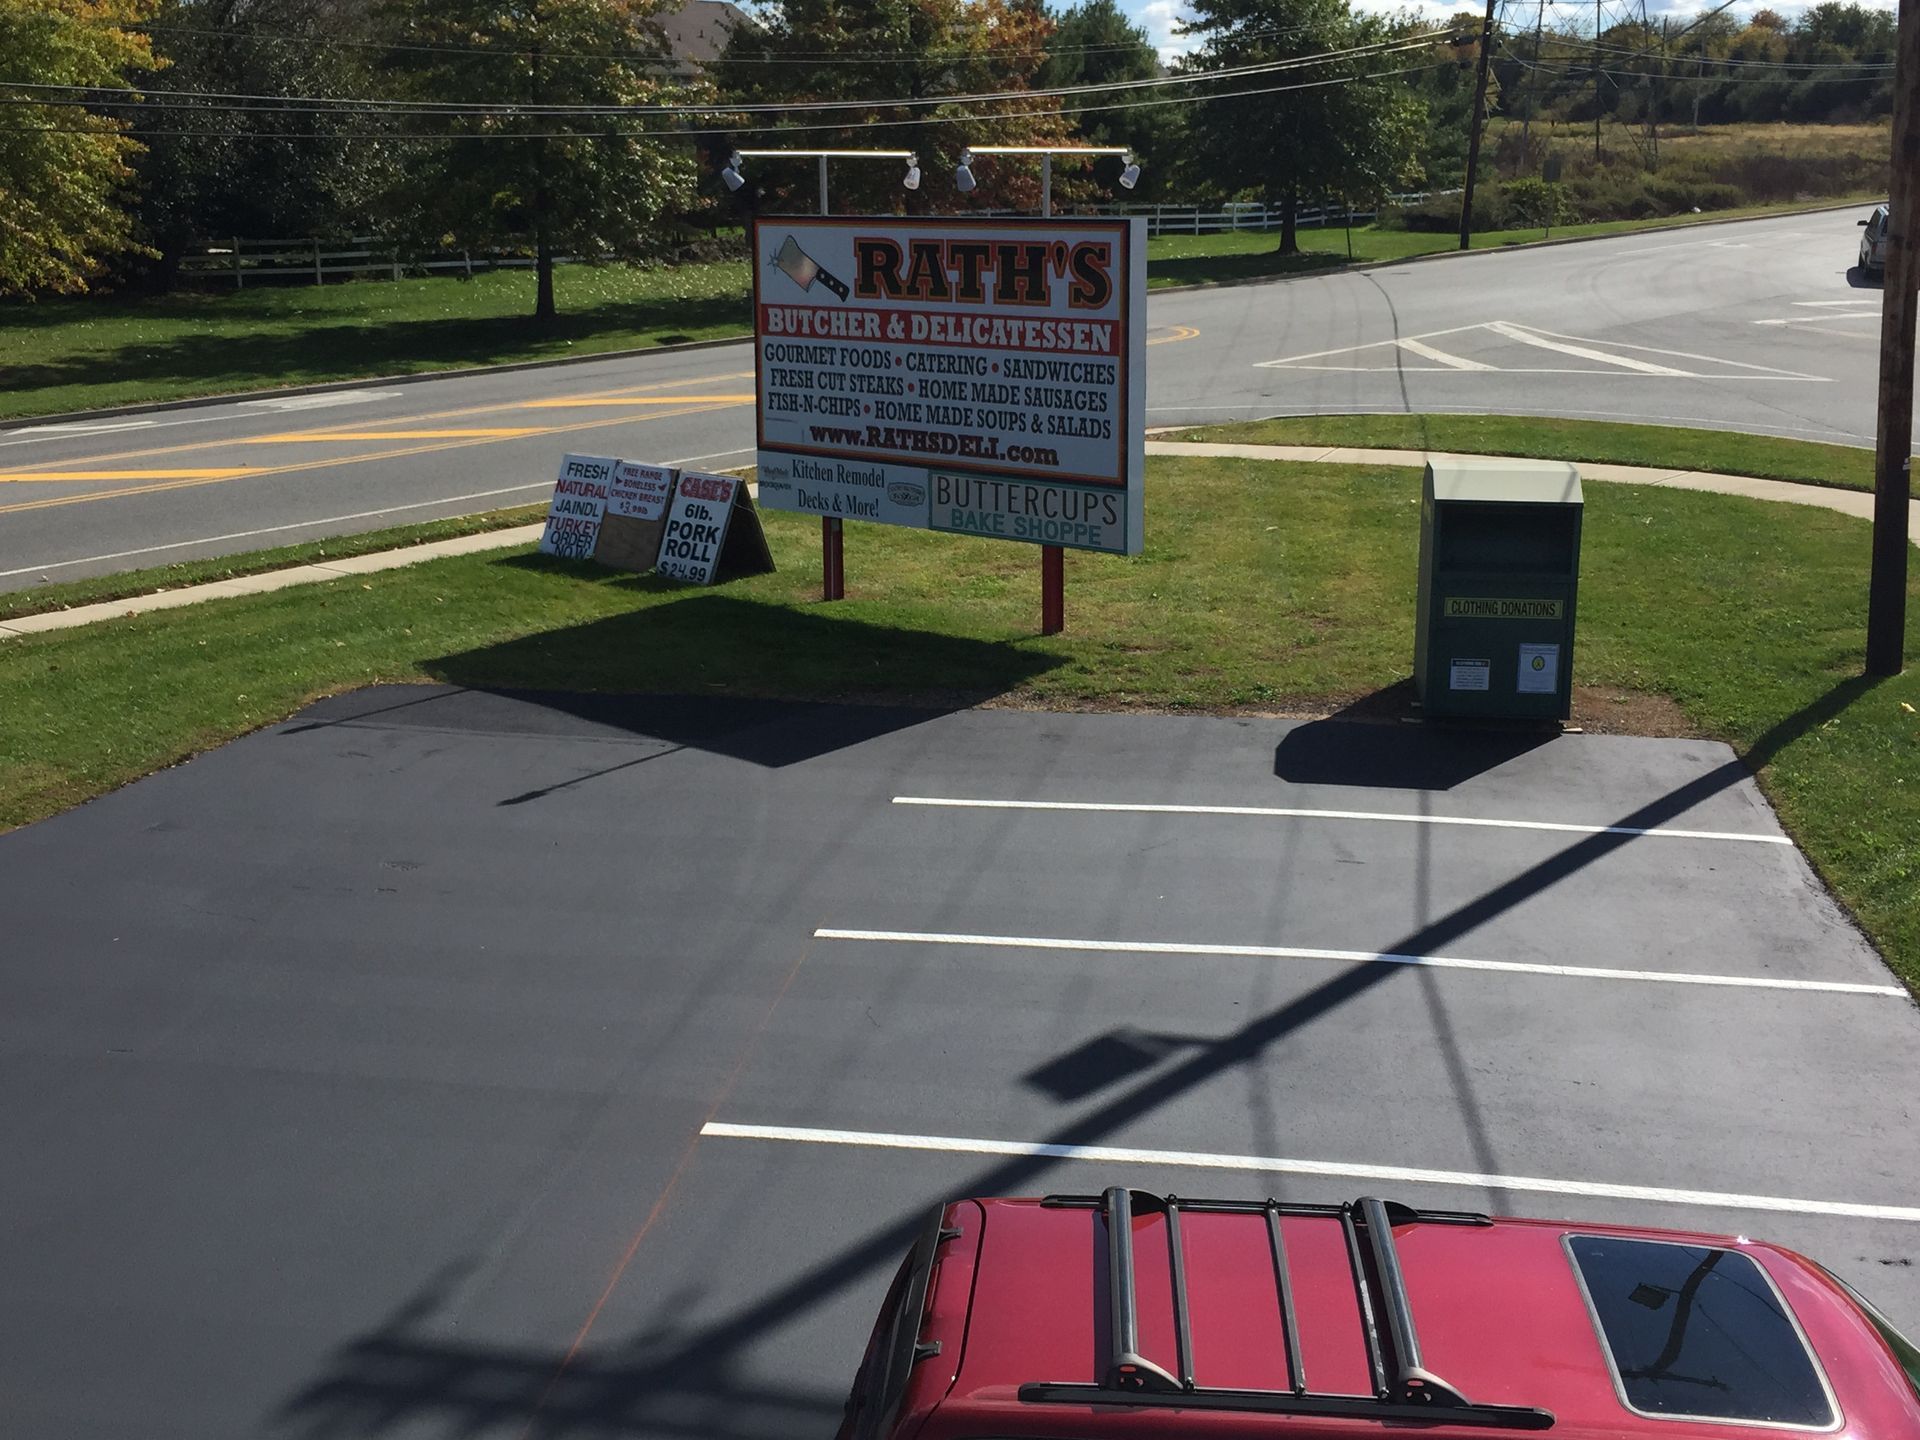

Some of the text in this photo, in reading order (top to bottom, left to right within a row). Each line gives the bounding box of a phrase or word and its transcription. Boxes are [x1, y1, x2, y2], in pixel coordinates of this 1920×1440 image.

[854, 237, 1112, 310] RATH'S
[767, 308, 1111, 352] BUTCHER & DELICATESSEN
[765, 343, 1115, 385] GOURMET FOODS CATERING SANDWICHES
[771, 368, 1107, 412] FRESH CUT STEAKS HOME MADE SAUSAGES
[768, 392, 1111, 440] FISH-N-CHIPS HOME MADE SOUPS & SALADS
[567, 462, 609, 480] FRESH
[623, 467, 639, 477] FREE
[792, 459, 833, 482] Kitchen
[837, 464, 885, 489] Remodel
[555, 479, 608, 500] NATURAL
[623, 479, 657, 491] BONELESS
[611, 489, 664, 504] CHICKEN BREAST
[798, 489, 829, 511] Decks
[832, 493, 842, 513] &
[846, 494, 879, 518] More!
[937, 476, 1117, 525] BUTTERCUPS
[556, 499, 599, 517] JAINDL
[685, 504, 713, 521] 6lb.
[548, 516, 600, 536] TURKEY
[667, 520, 720, 544] PORK
[952, 508, 1101, 545] BAKE SHOPPE
[550, 530, 593, 549] ORDER
[555, 544, 588, 560] NOW
[665, 539, 710, 563] ROLL
[1451, 601, 1555, 616] CLOTHING DONATIONS
